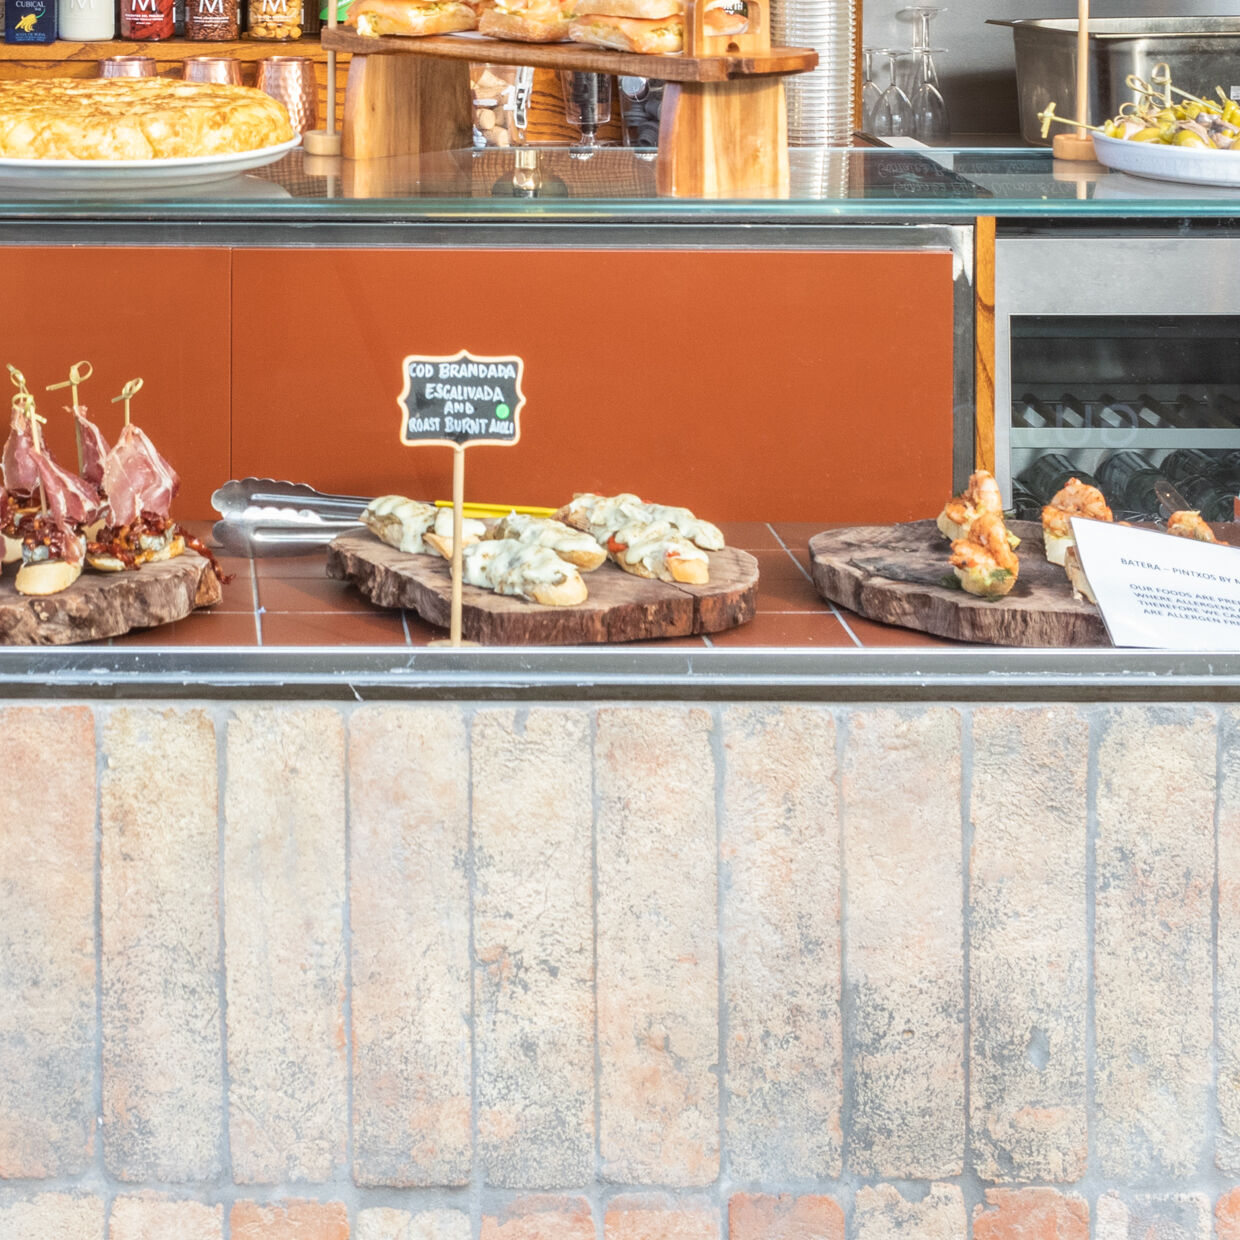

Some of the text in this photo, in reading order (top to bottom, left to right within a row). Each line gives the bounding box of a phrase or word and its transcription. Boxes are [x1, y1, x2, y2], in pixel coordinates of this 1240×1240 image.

[409, 363, 516, 379] COD BRANDADA
[424, 383, 505, 402] ESCALIVADA
[443, 401, 475, 415] AND
[408, 417, 441, 433] ROAST
[444, 416, 488, 434] BURNT
[1120, 557, 1231, 583] BATERA PINTXOS BY
[1129, 583, 1154, 593] OUR
[1155, 587, 1192, 598] FOODS
